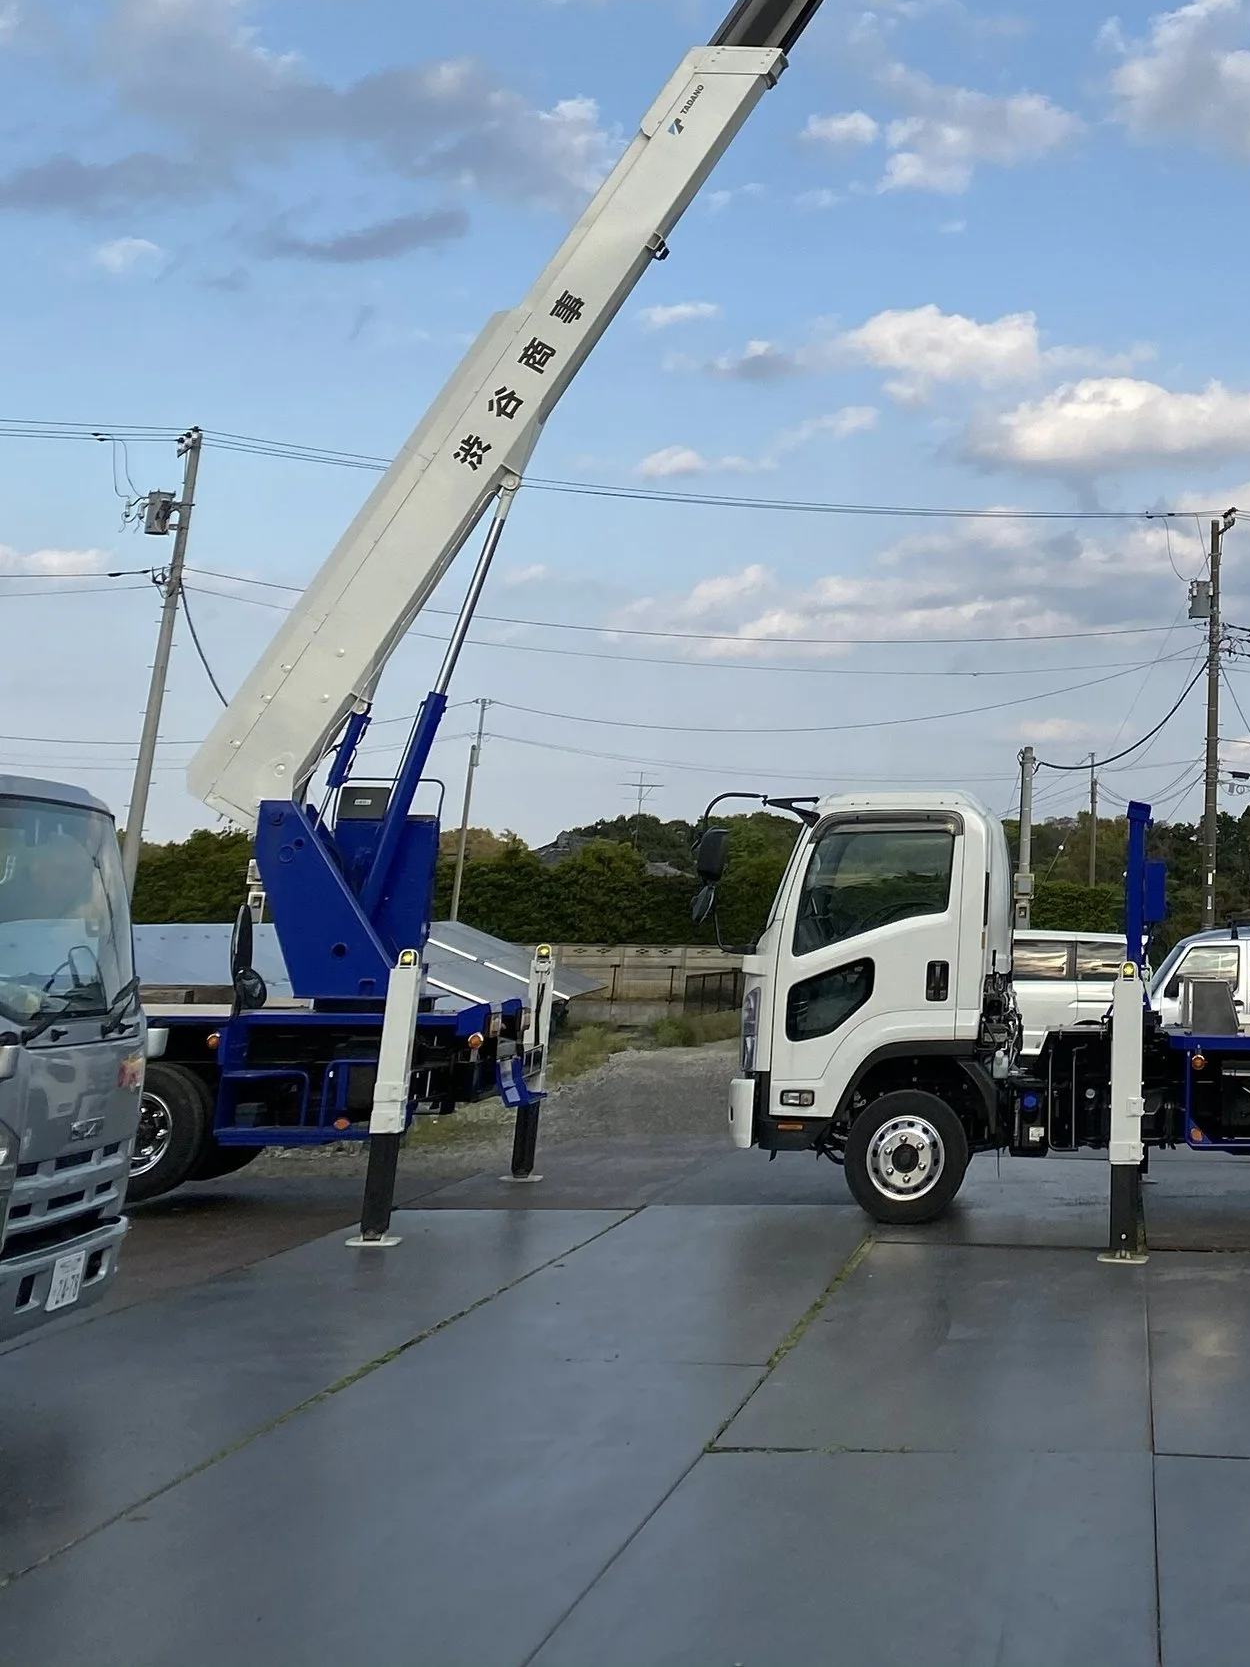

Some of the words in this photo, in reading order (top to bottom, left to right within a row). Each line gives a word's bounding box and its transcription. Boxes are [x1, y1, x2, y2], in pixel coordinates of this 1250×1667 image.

[679, 83, 705, 115] TADANO
[452, 289, 586, 472] 渋谷商事
